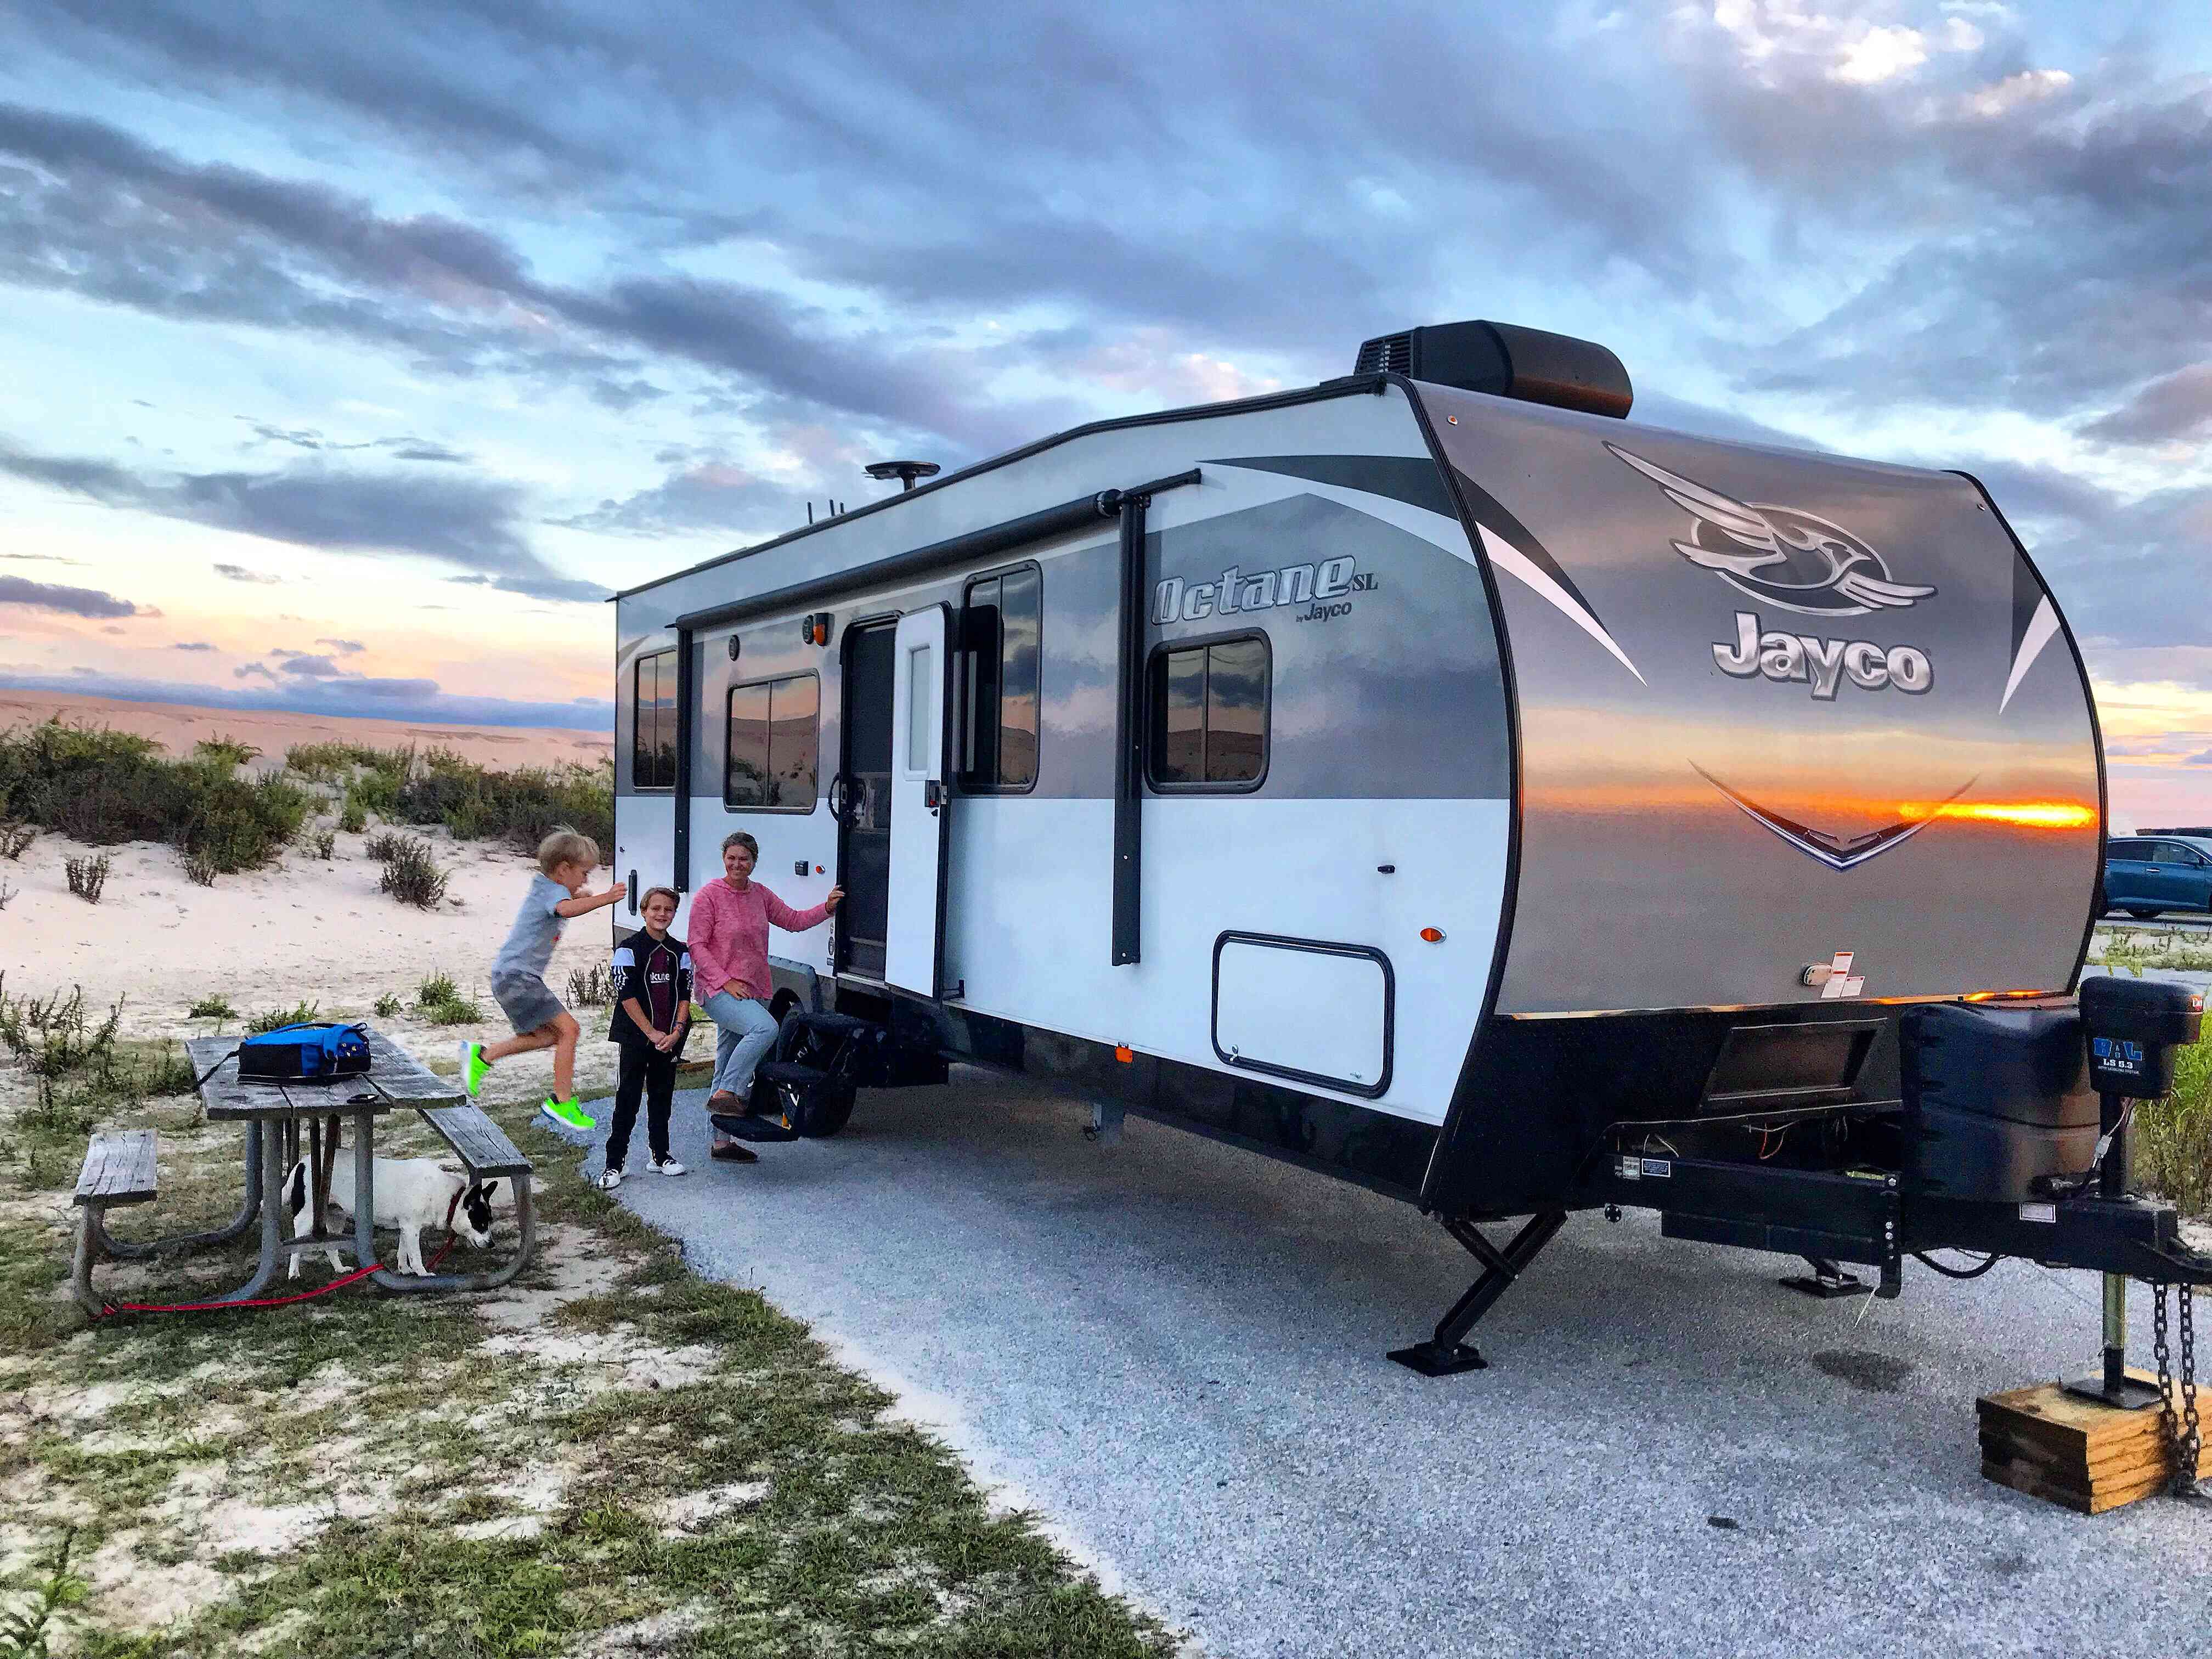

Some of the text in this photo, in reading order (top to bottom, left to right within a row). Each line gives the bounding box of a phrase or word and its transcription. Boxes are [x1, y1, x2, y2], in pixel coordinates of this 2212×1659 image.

[1152, 555, 1378, 625] Octane SL
[1304, 602, 1352, 622] Jayco
[1711, 610, 1934, 701] Jayco
[2103, 1058, 2116, 1066] LS
